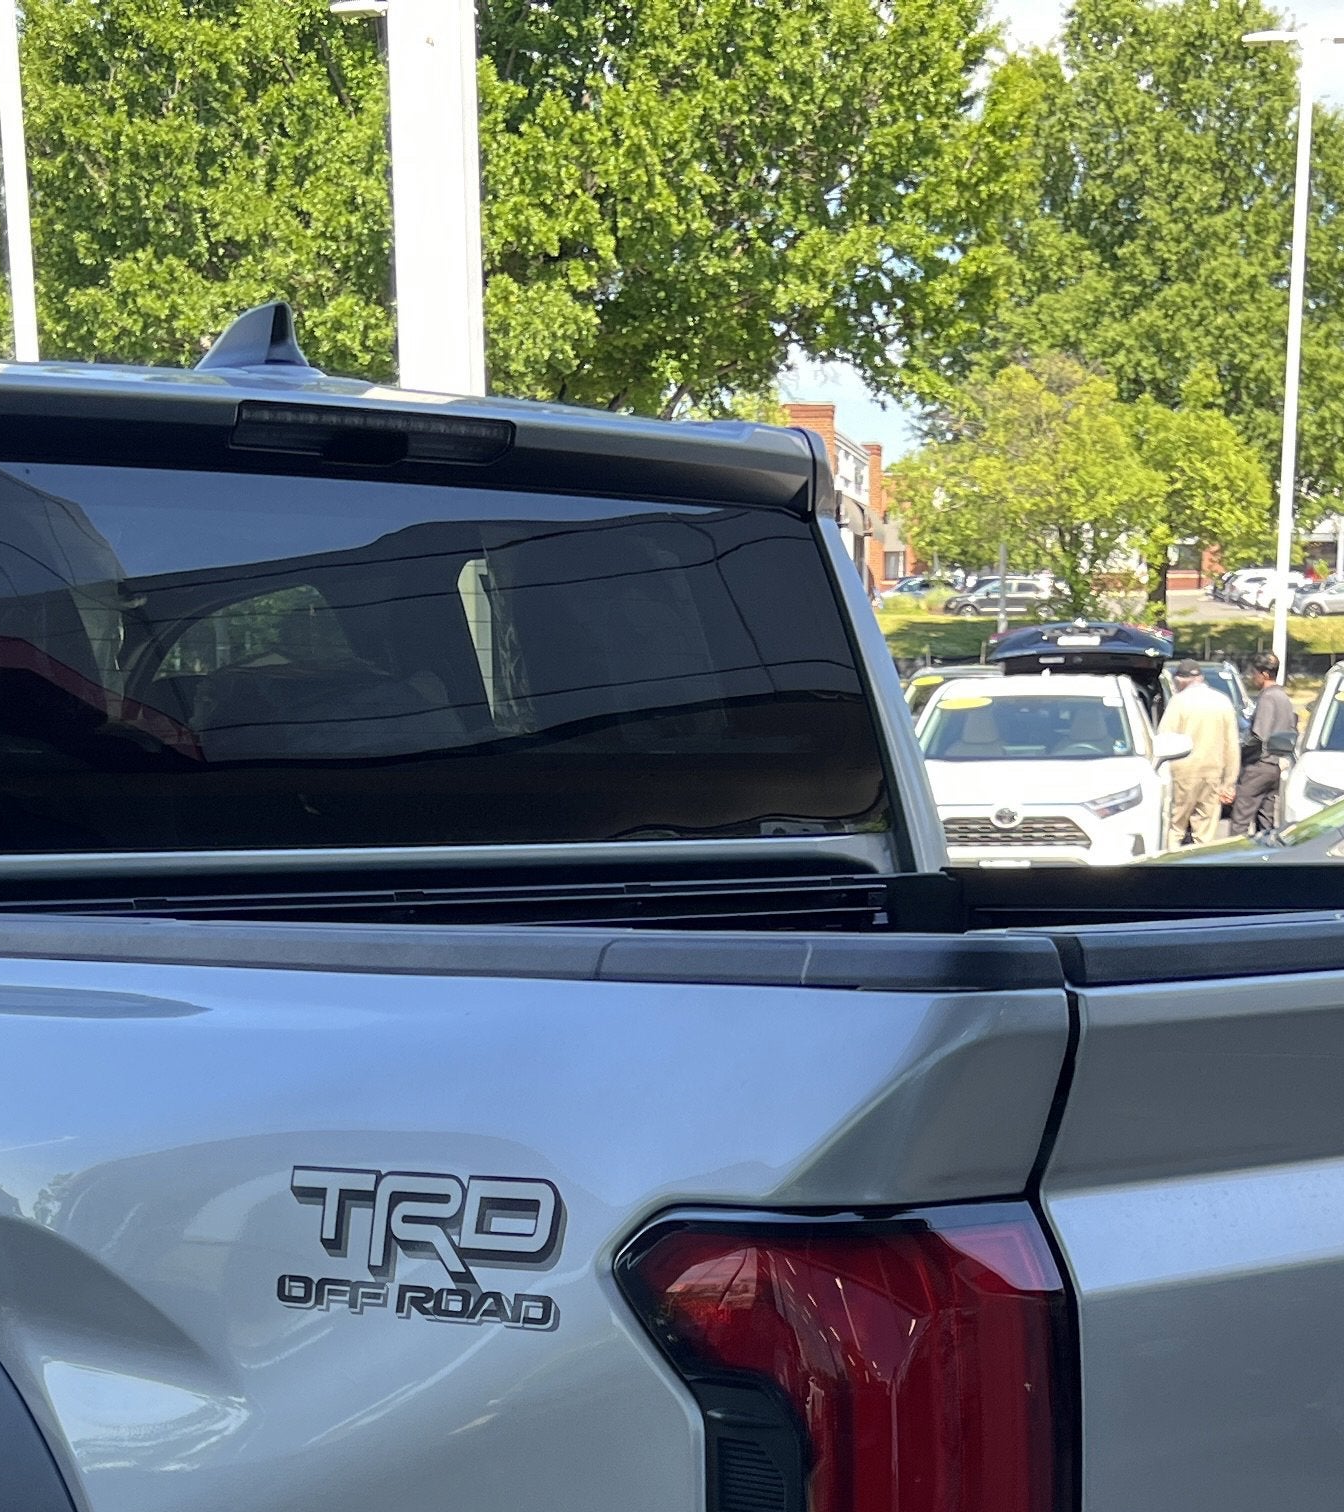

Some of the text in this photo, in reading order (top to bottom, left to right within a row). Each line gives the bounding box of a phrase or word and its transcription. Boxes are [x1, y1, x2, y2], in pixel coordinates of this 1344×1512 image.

[291, 1165, 566, 1290] TRD
[277, 1274, 560, 1331] OFF ROAD
